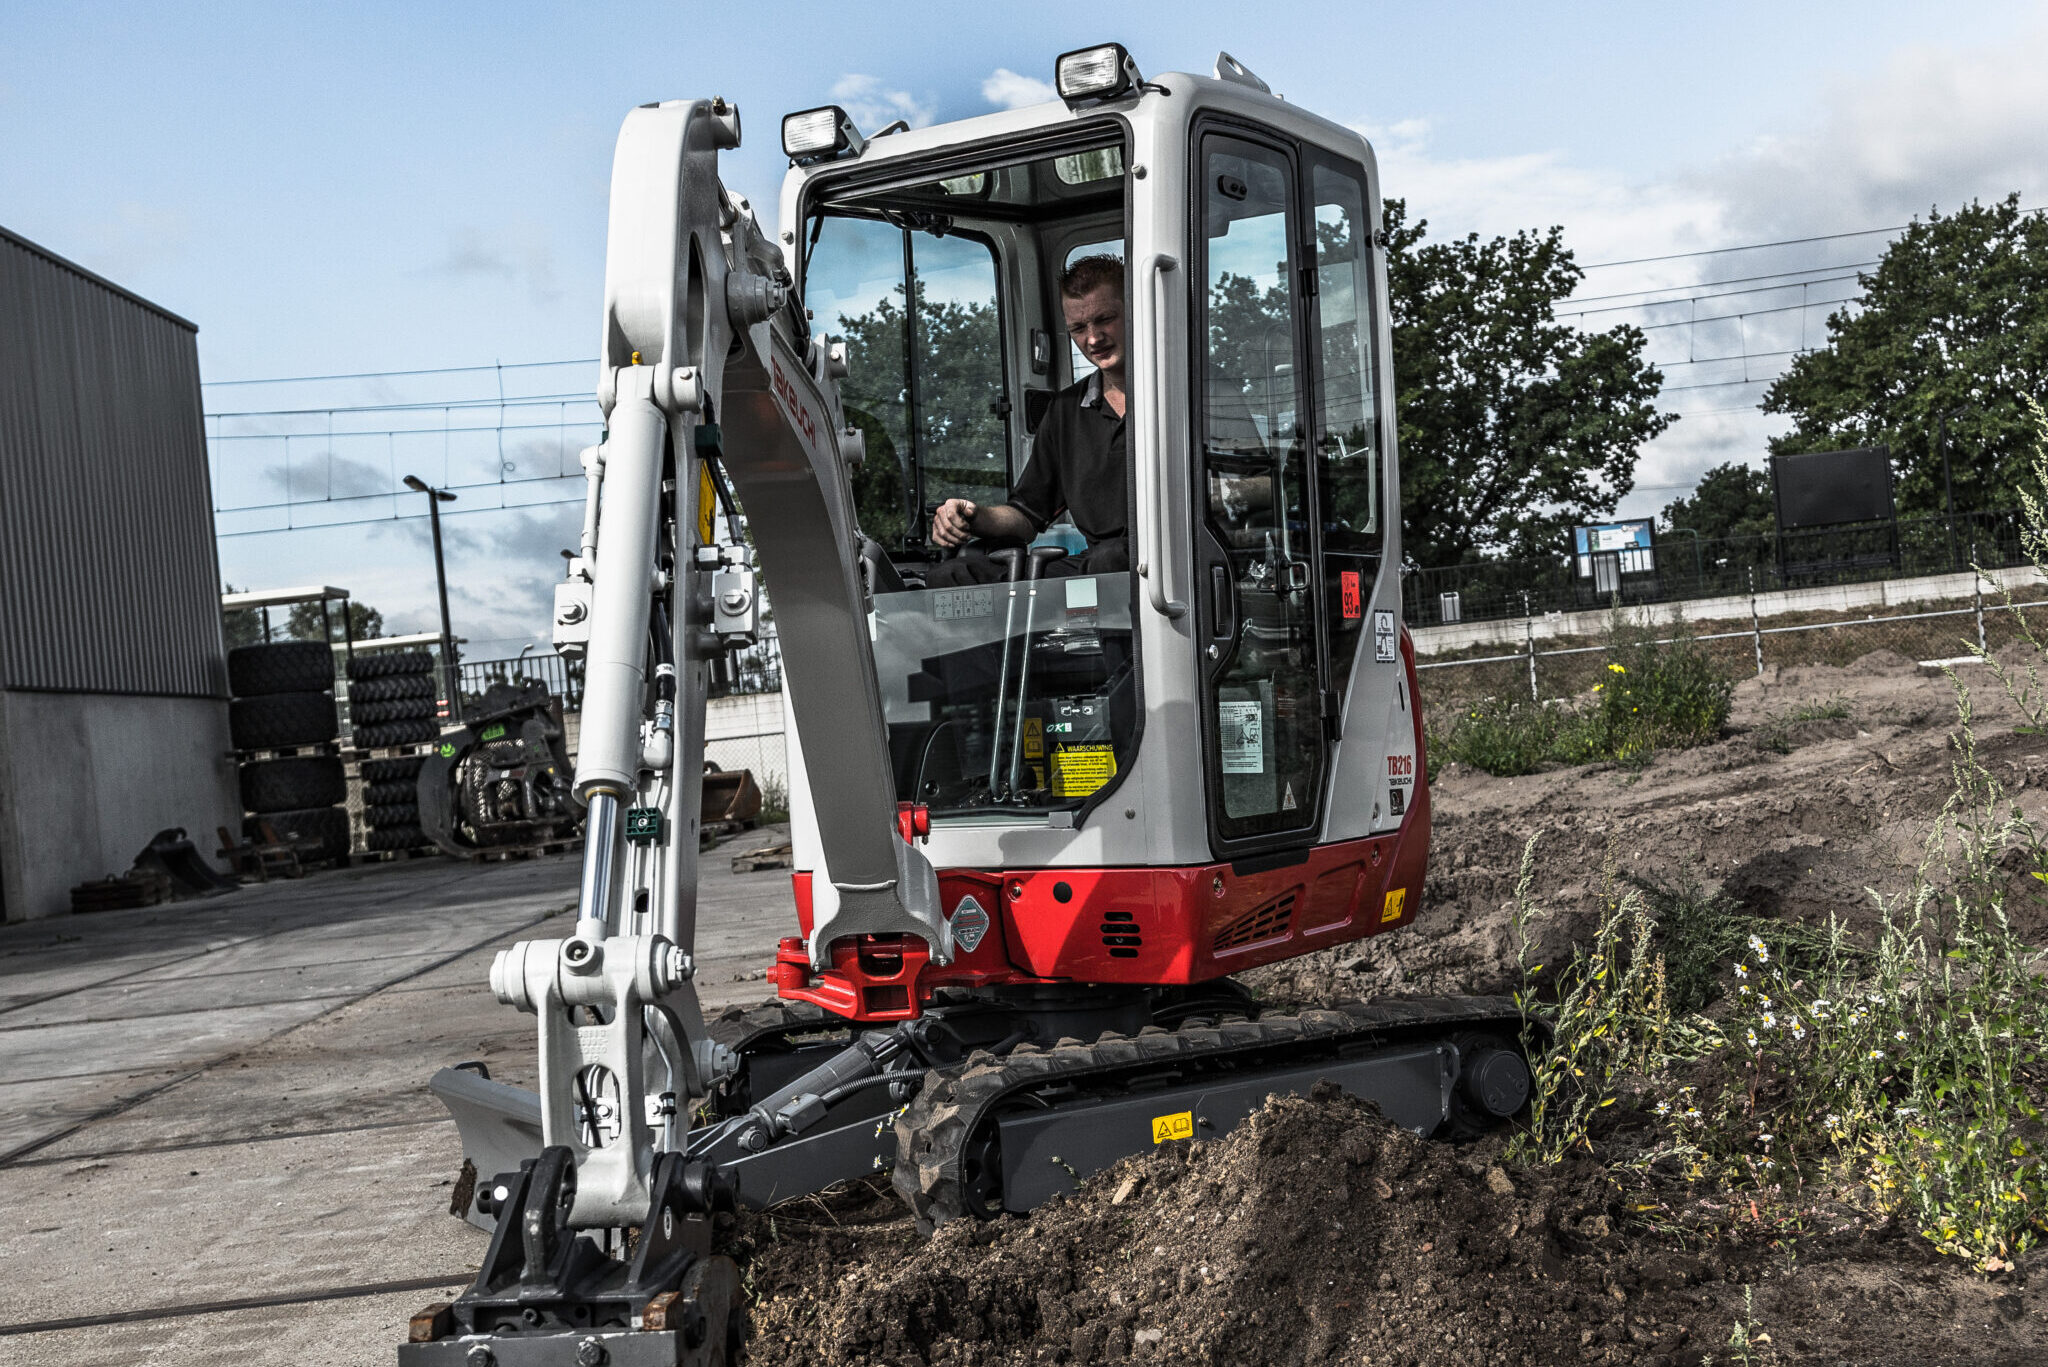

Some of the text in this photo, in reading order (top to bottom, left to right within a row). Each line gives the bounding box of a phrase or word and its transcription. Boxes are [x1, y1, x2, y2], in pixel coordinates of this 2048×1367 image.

[1345, 593, 1354, 615] 93
[1066, 744, 1113, 752] WAARSCHUWING
[1387, 755, 1412, 776] TB216
